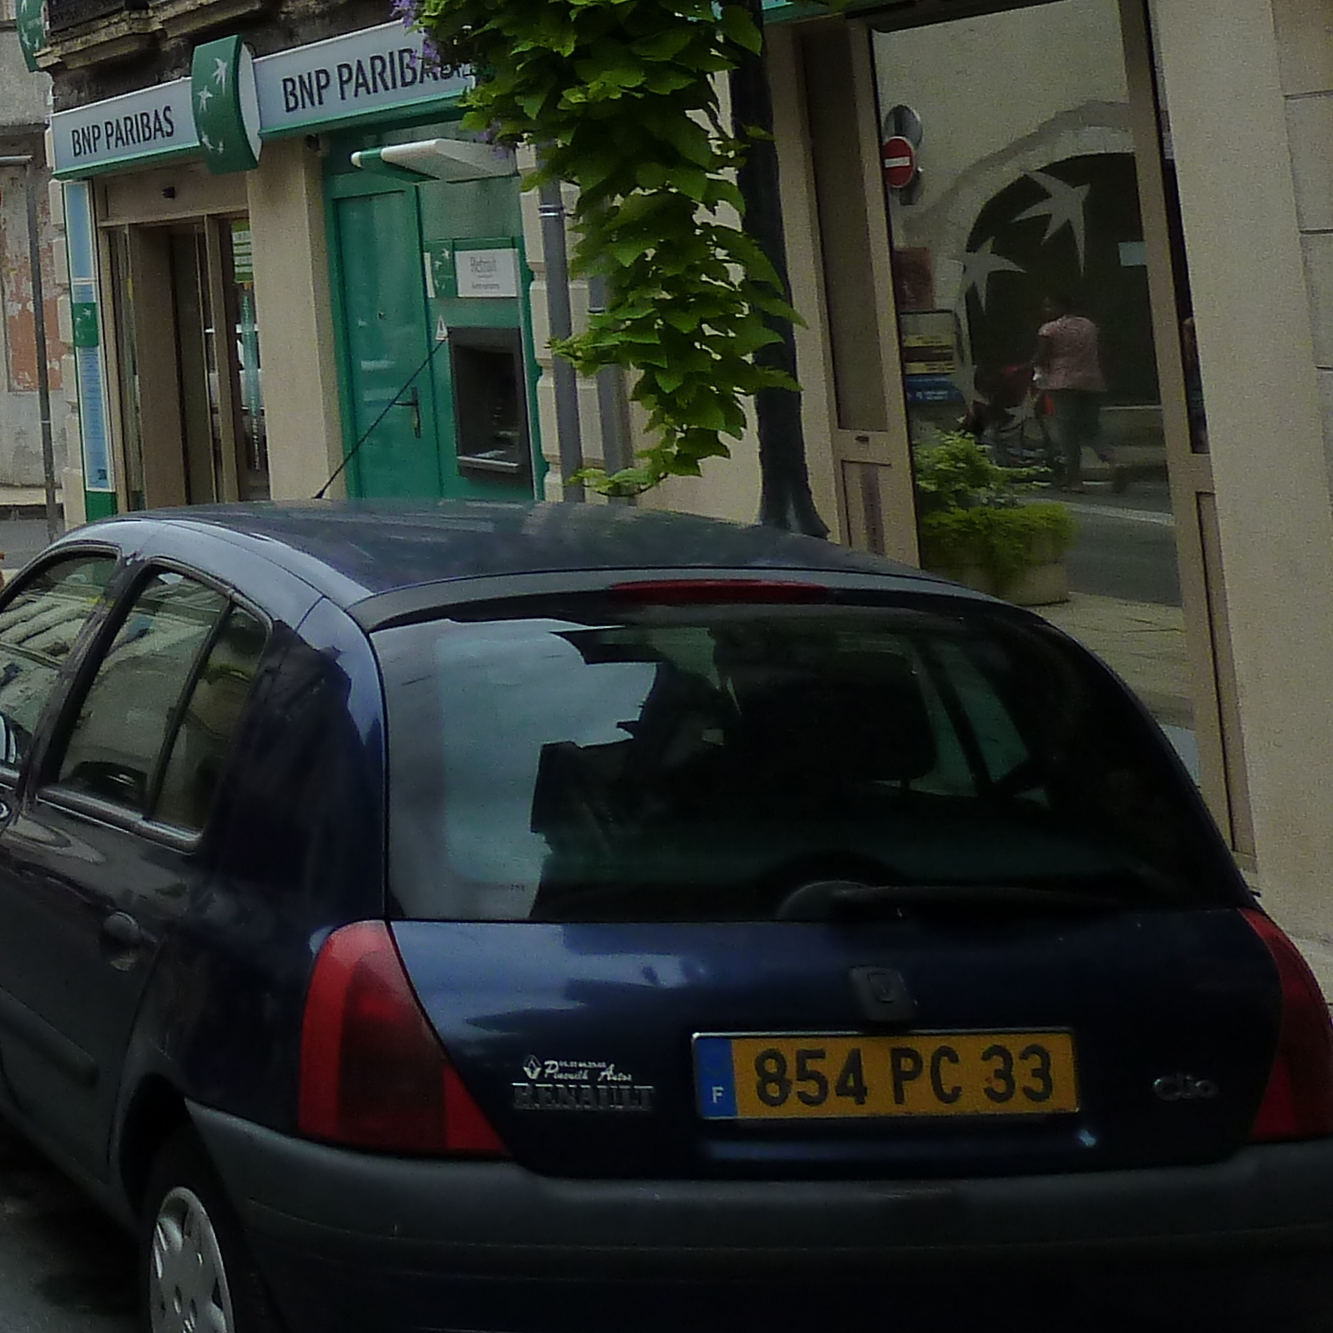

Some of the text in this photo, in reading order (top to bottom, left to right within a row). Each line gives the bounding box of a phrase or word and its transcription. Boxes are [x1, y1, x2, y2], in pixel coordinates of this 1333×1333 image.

[282, 68, 331, 113] BNP
[71, 105, 175, 157] BNP PARIBAS
[511, 1082, 654, 1112] RENAULT
[711, 1043, 1054, 1107] F 854 PC 33
